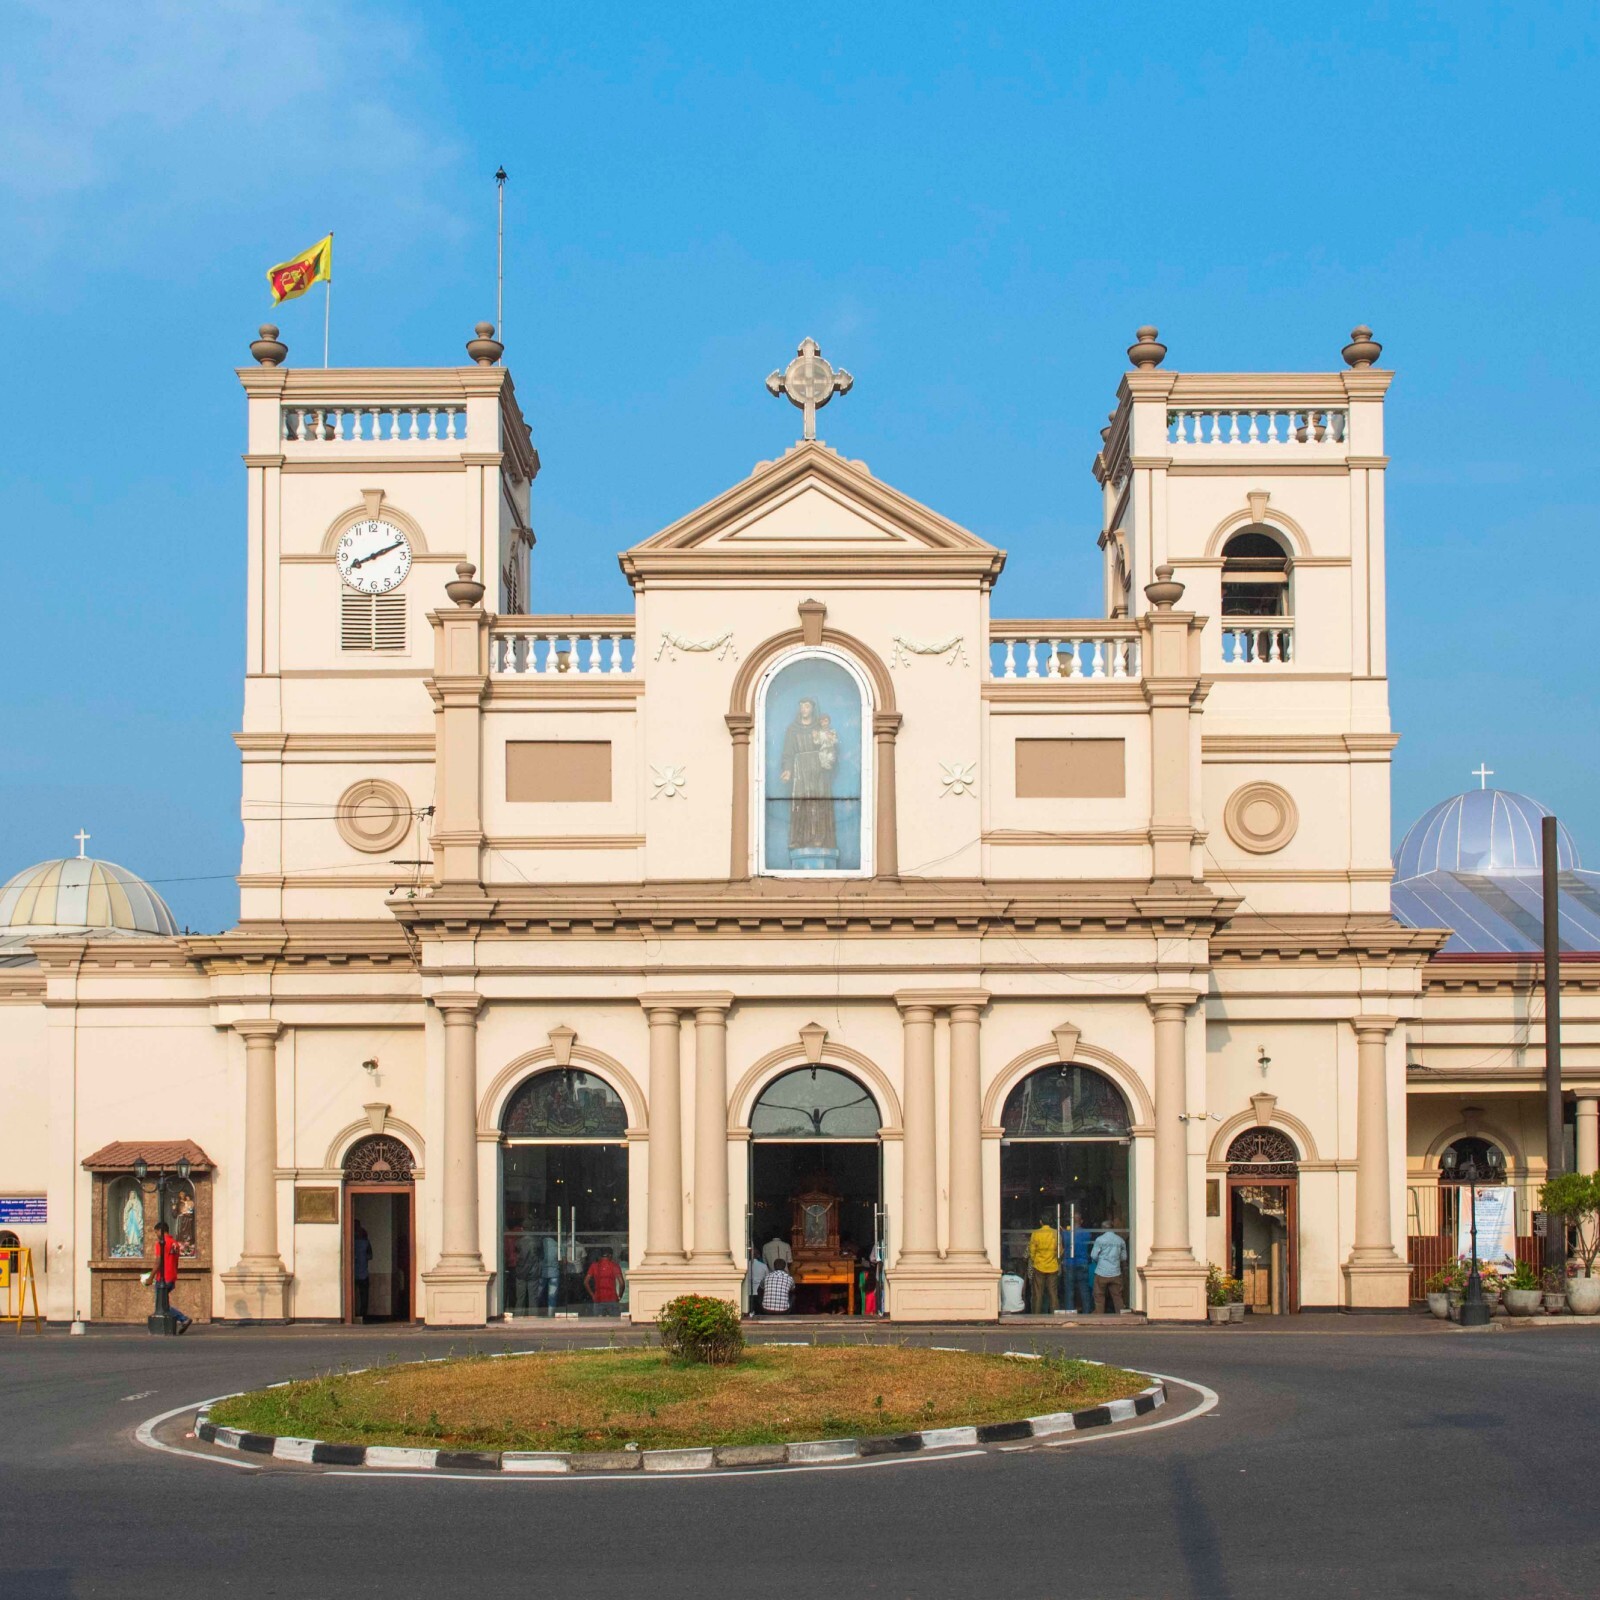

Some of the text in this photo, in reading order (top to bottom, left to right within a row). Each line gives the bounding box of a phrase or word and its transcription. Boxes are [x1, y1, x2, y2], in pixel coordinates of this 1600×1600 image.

[356, 528, 362, 536] 11
[368, 524, 378, 532] 12
[395, 534, 402, 543] 2
[341, 552, 348, 561] 9
[400, 552, 406, 560] 3
[345, 567, 352, 576] 8
[394, 565, 401, 574] 4
[357, 578, 363, 586] 7
[370, 581, 377, 590] 6
[384, 578, 391, 587] 5
